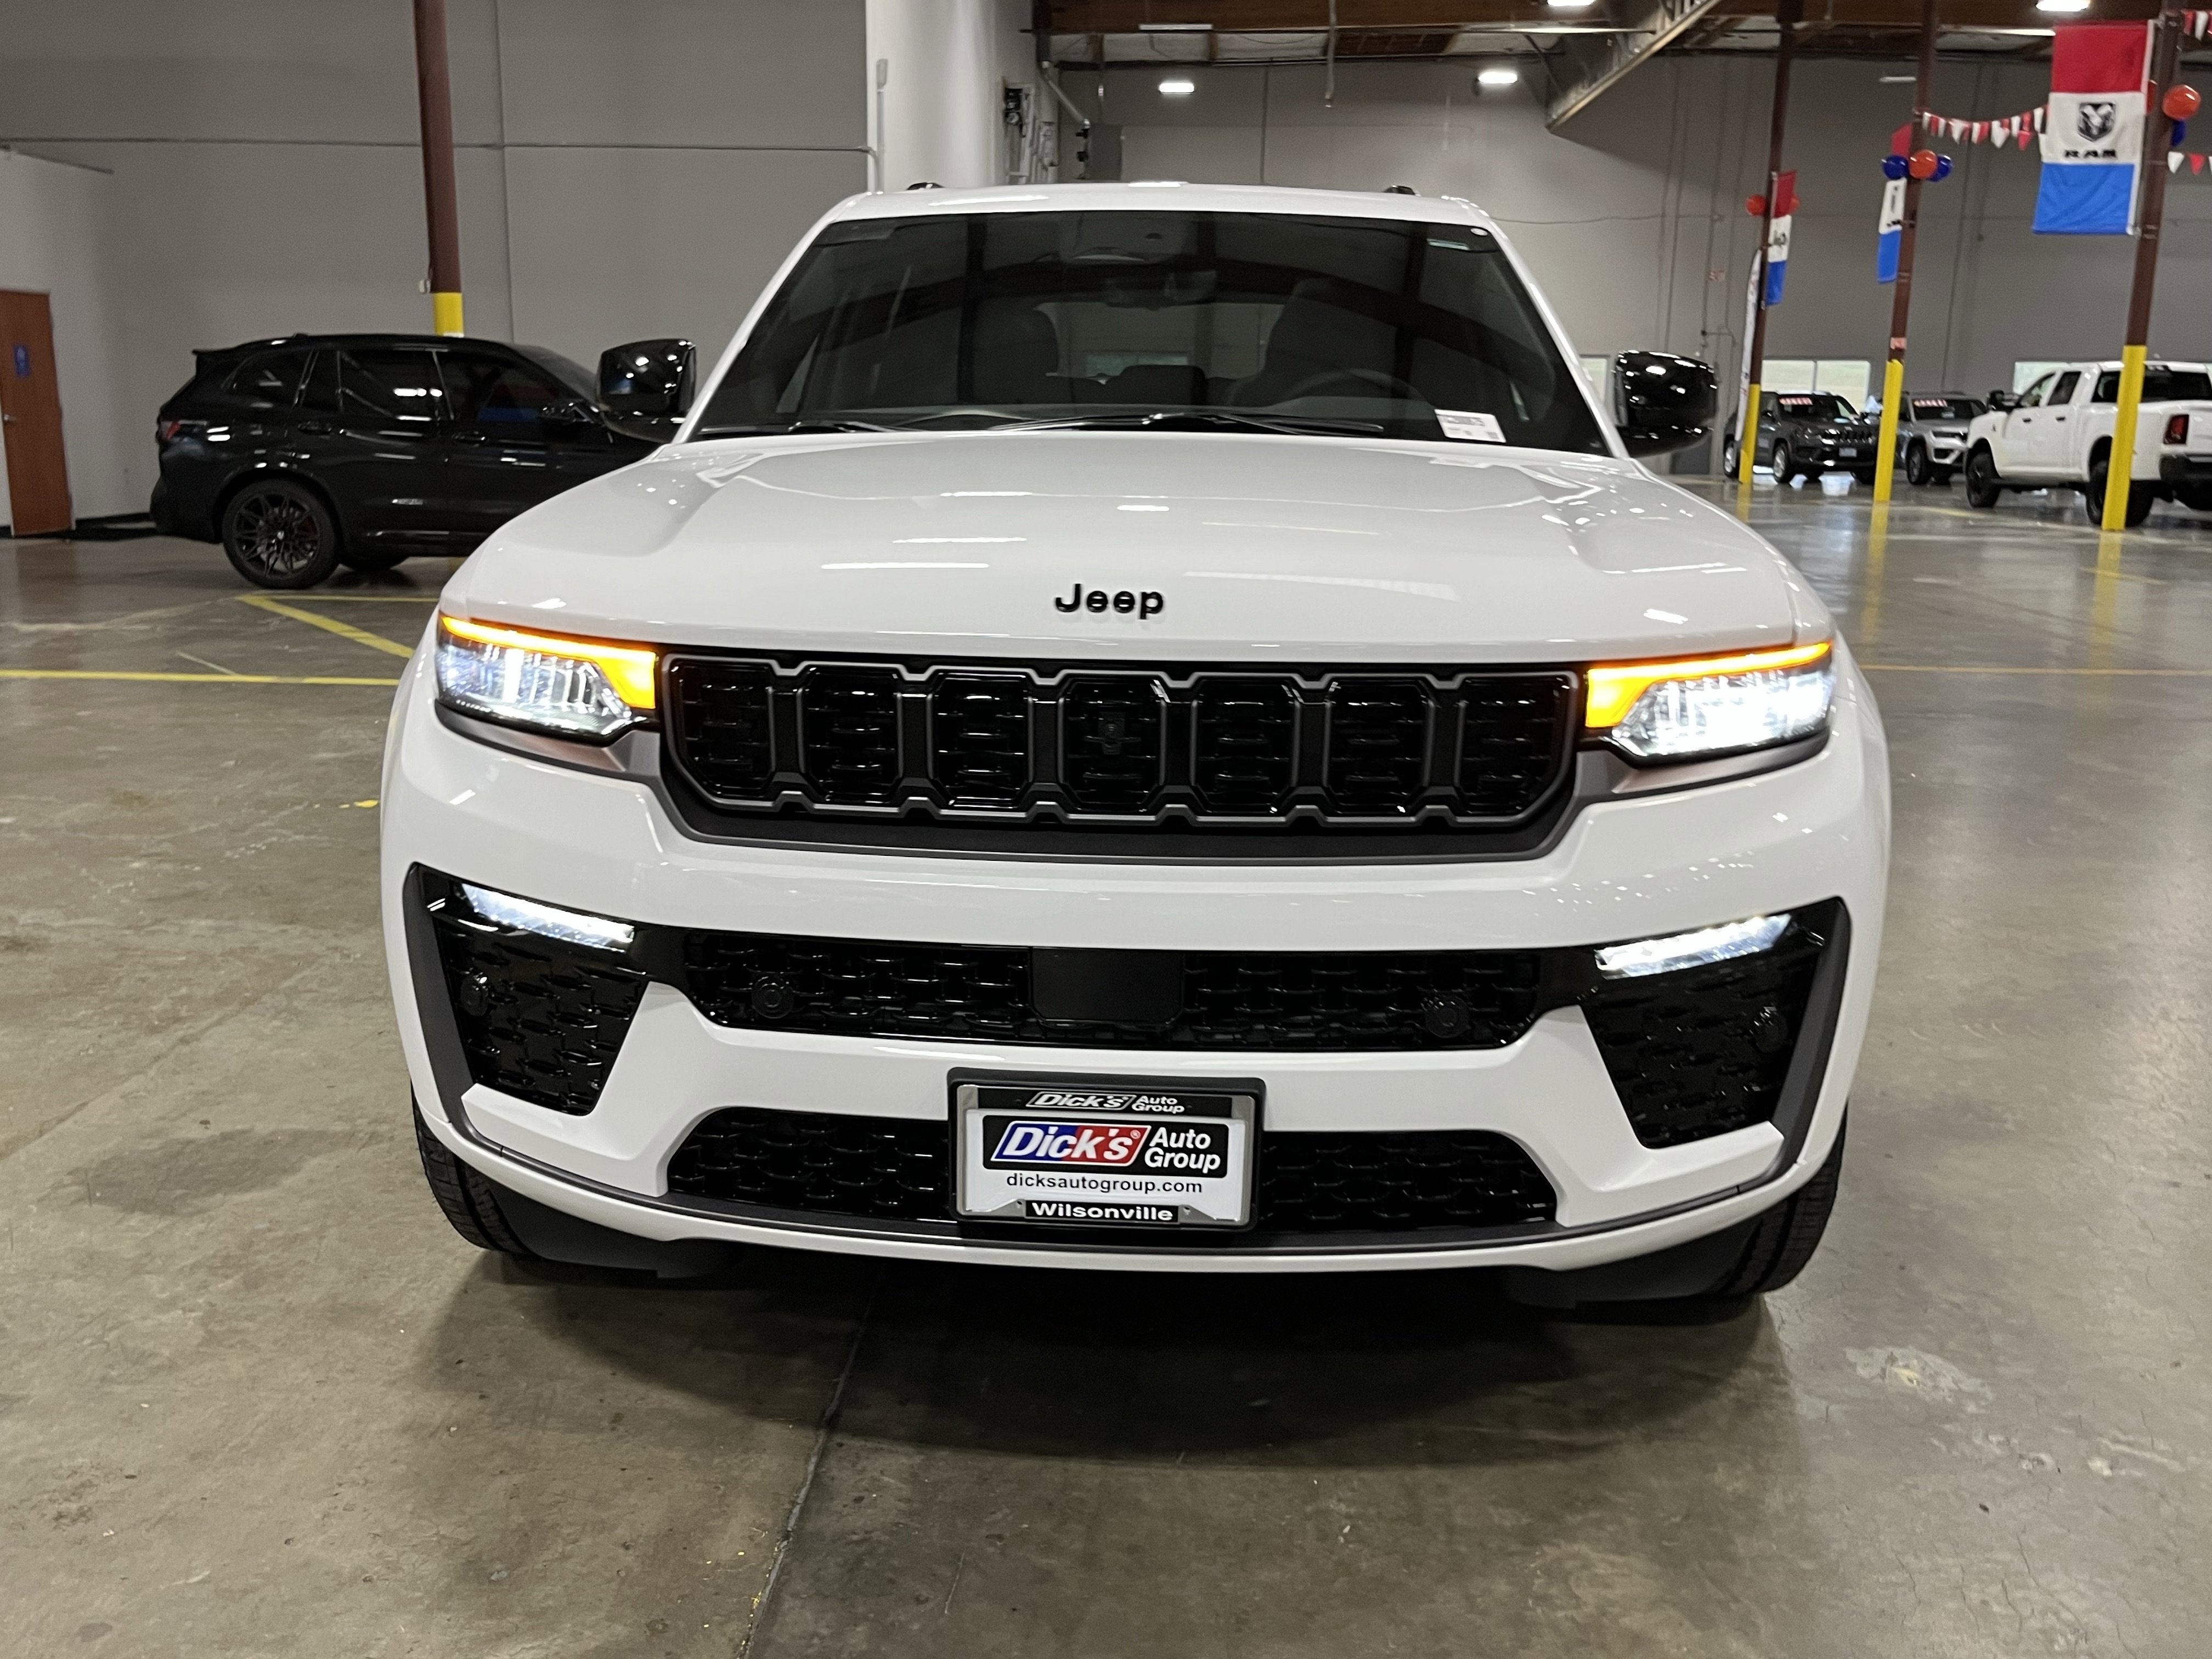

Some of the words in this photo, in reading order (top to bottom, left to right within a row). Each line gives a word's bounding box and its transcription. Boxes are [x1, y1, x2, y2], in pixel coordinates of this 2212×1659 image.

[1056, 583, 1164, 619] Jeep
[1034, 1093, 1124, 1108] Dick's
[1131, 1102, 1185, 1114] Group
[1136, 1096, 1178, 1105] Auto
[1001, 1125, 1133, 1161] Dick's
[1149, 1126, 1211, 1149] Auto
[1144, 1147, 1221, 1173] Group
[1006, 1173, 1203, 1194] dicksautogroup.com
[1031, 1202, 1173, 1221] Wilsonville
